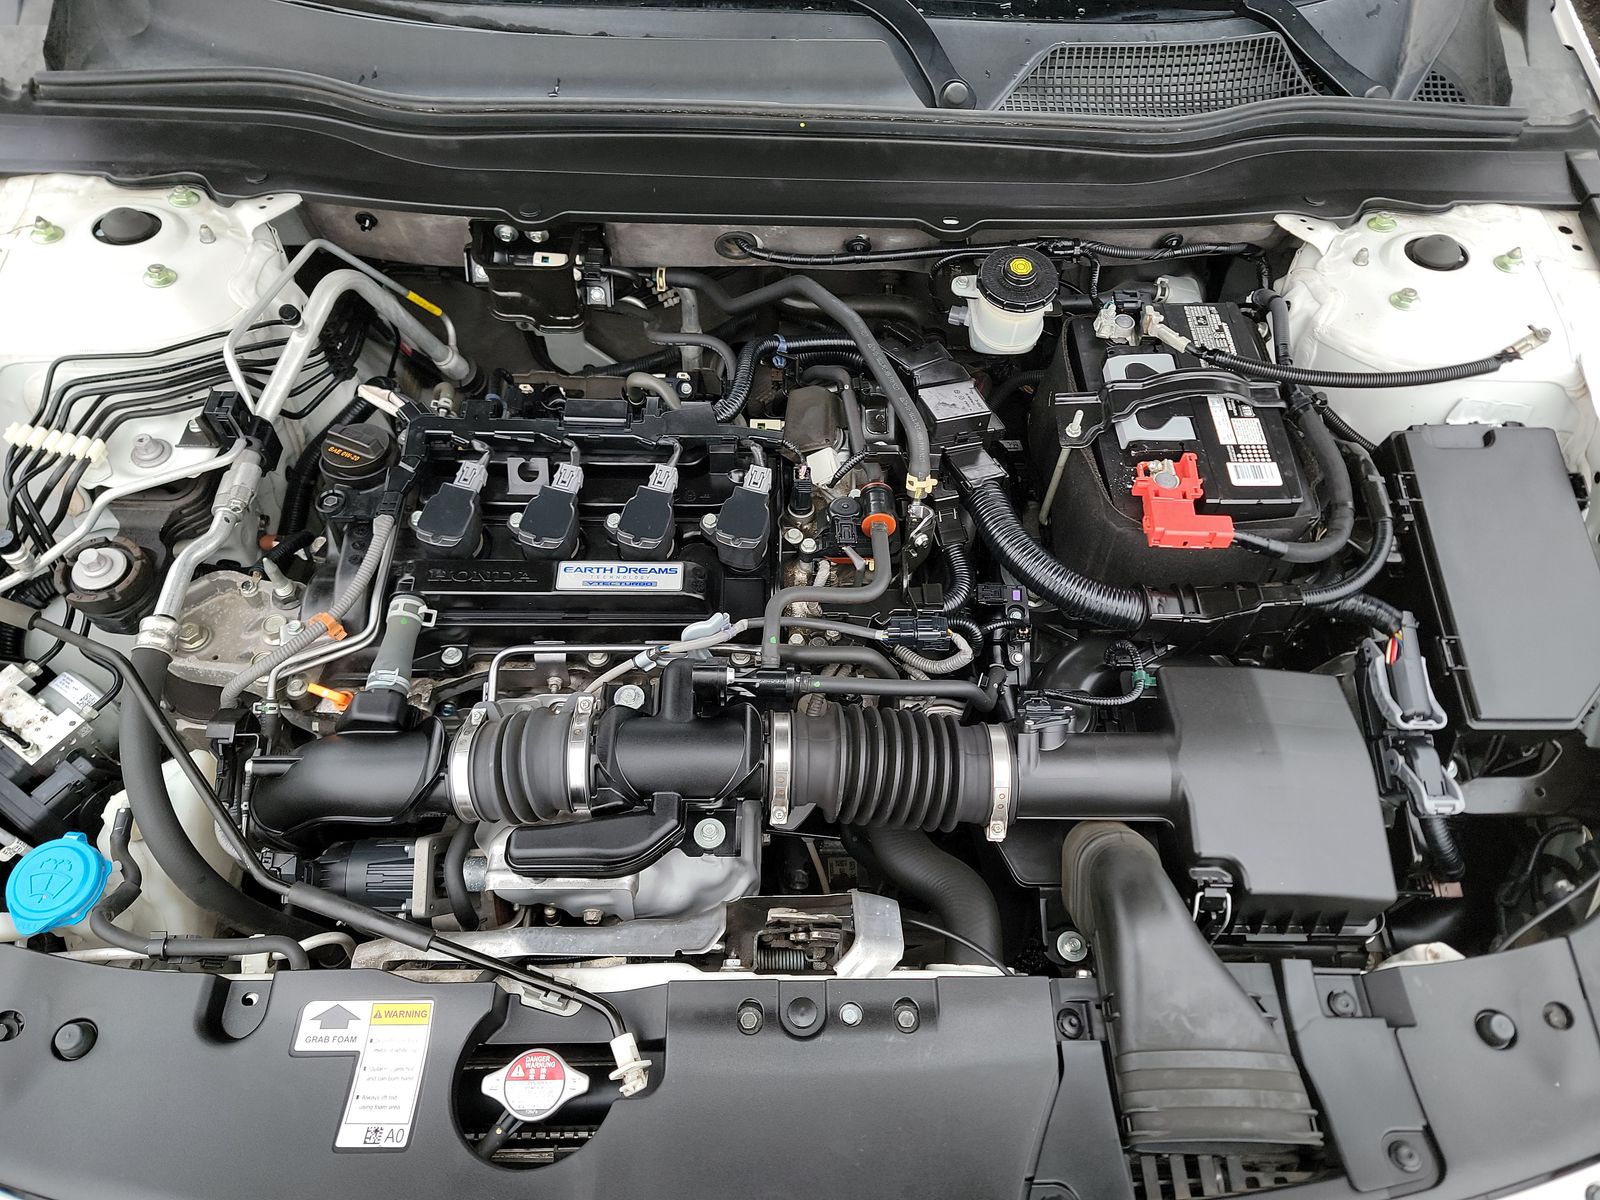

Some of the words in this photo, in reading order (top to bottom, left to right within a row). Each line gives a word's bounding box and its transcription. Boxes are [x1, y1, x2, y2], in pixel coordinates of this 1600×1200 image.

[328, 446, 342, 454] SAE
[341, 451, 360, 461] 0W-20
[427, 569, 538, 582] HONDA
[563, 566, 613, 574] EARTH
[616, 566, 678, 575] DREAMS
[384, 1010, 428, 1019] WARNING
[384, 1128, 405, 1144] A0
